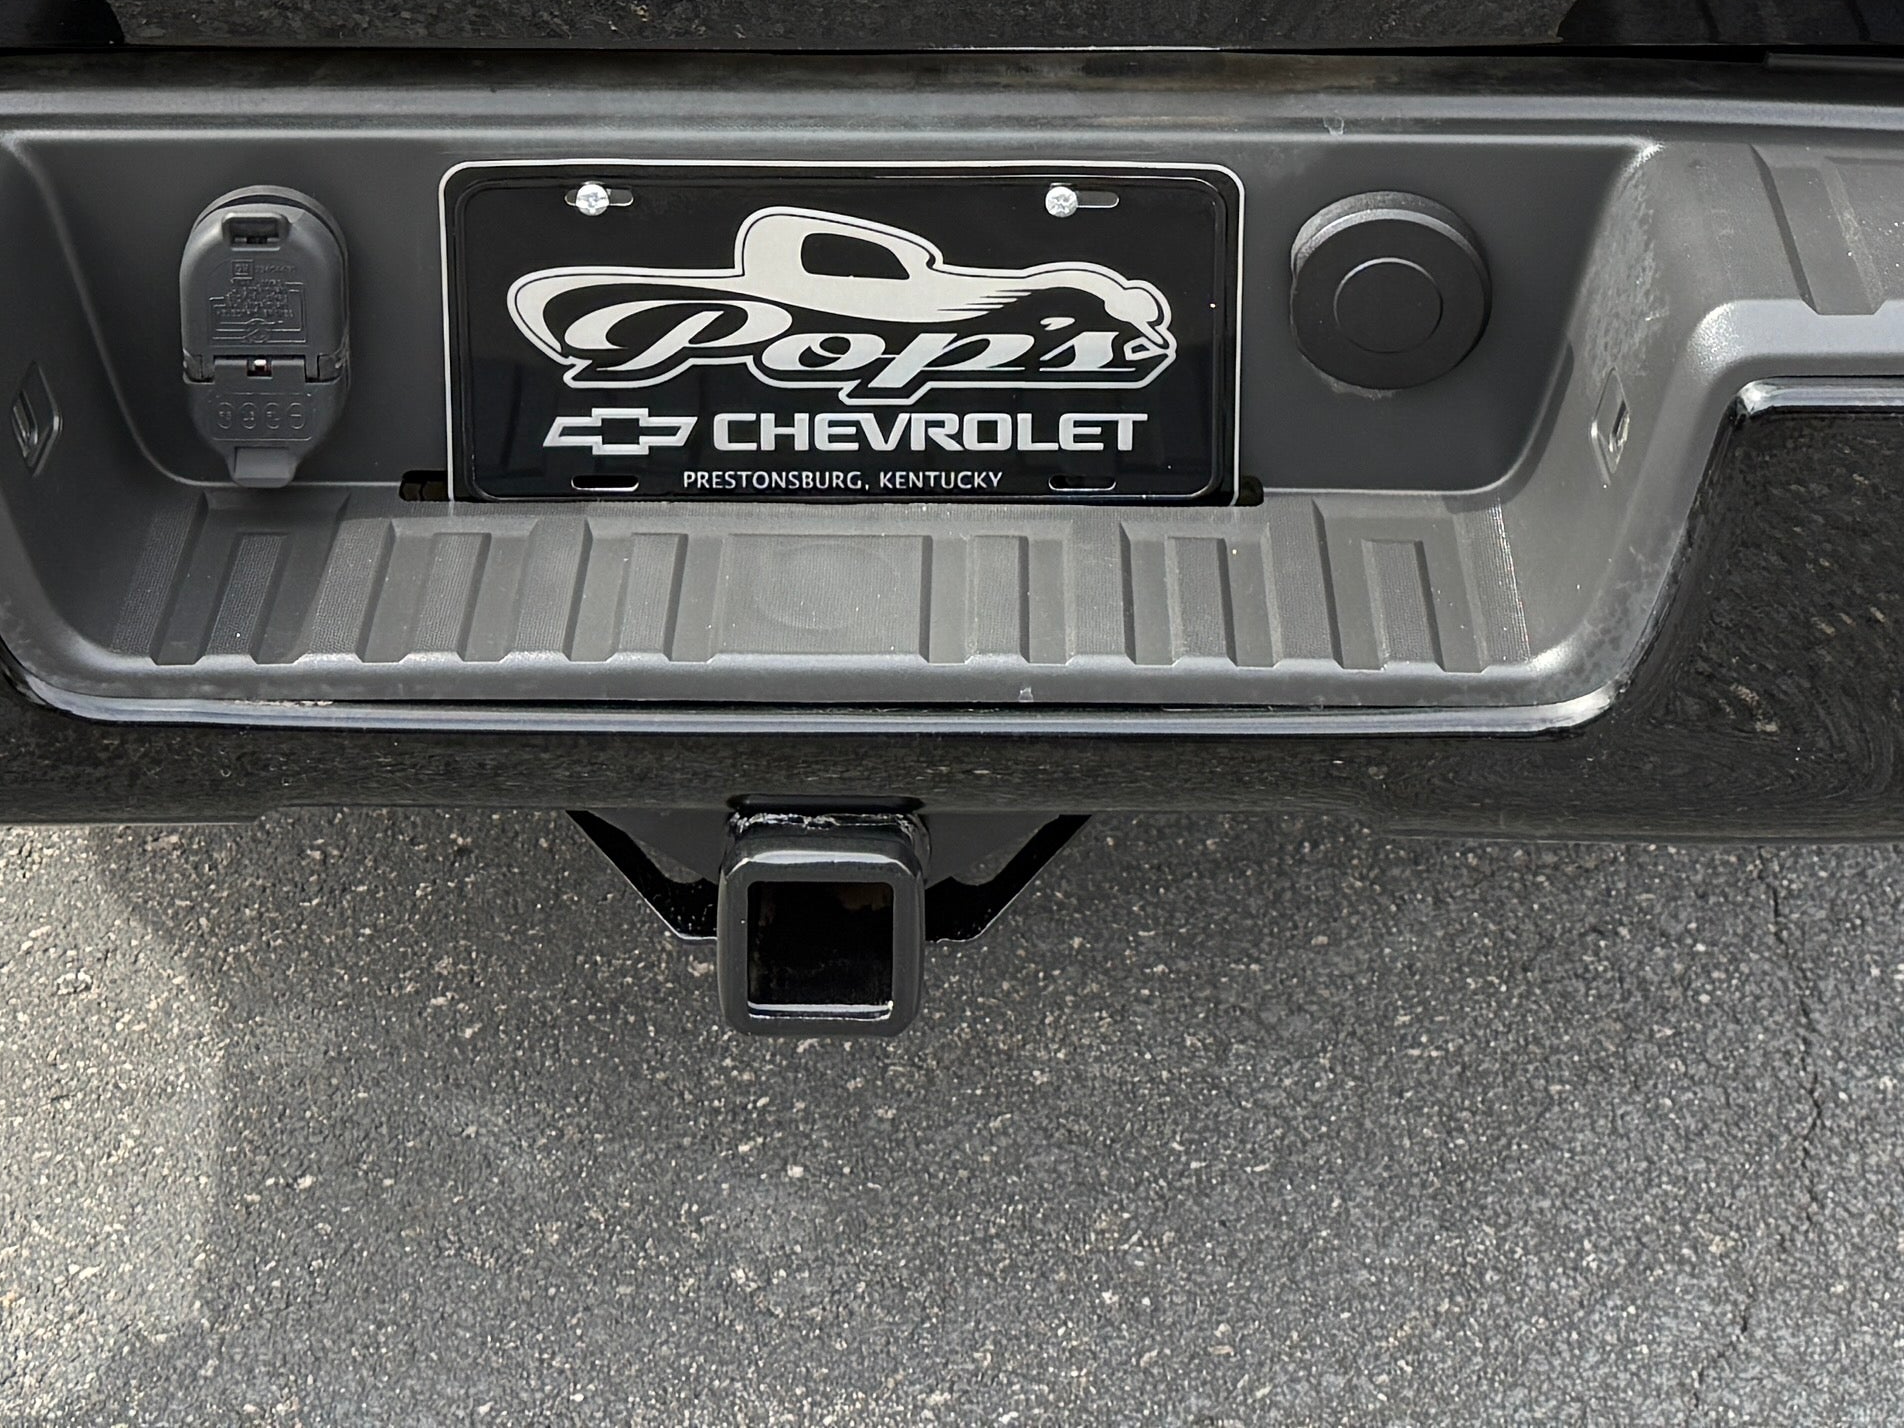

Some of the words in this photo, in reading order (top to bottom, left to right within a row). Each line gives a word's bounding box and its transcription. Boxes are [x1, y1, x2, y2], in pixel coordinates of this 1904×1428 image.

[563, 297, 1138, 390] Pop's
[712, 411, 1149, 453] CHEVROLET
[682, 469, 872, 491] PRESTONSBURG,
[879, 469, 1004, 490] KENTUCKY
